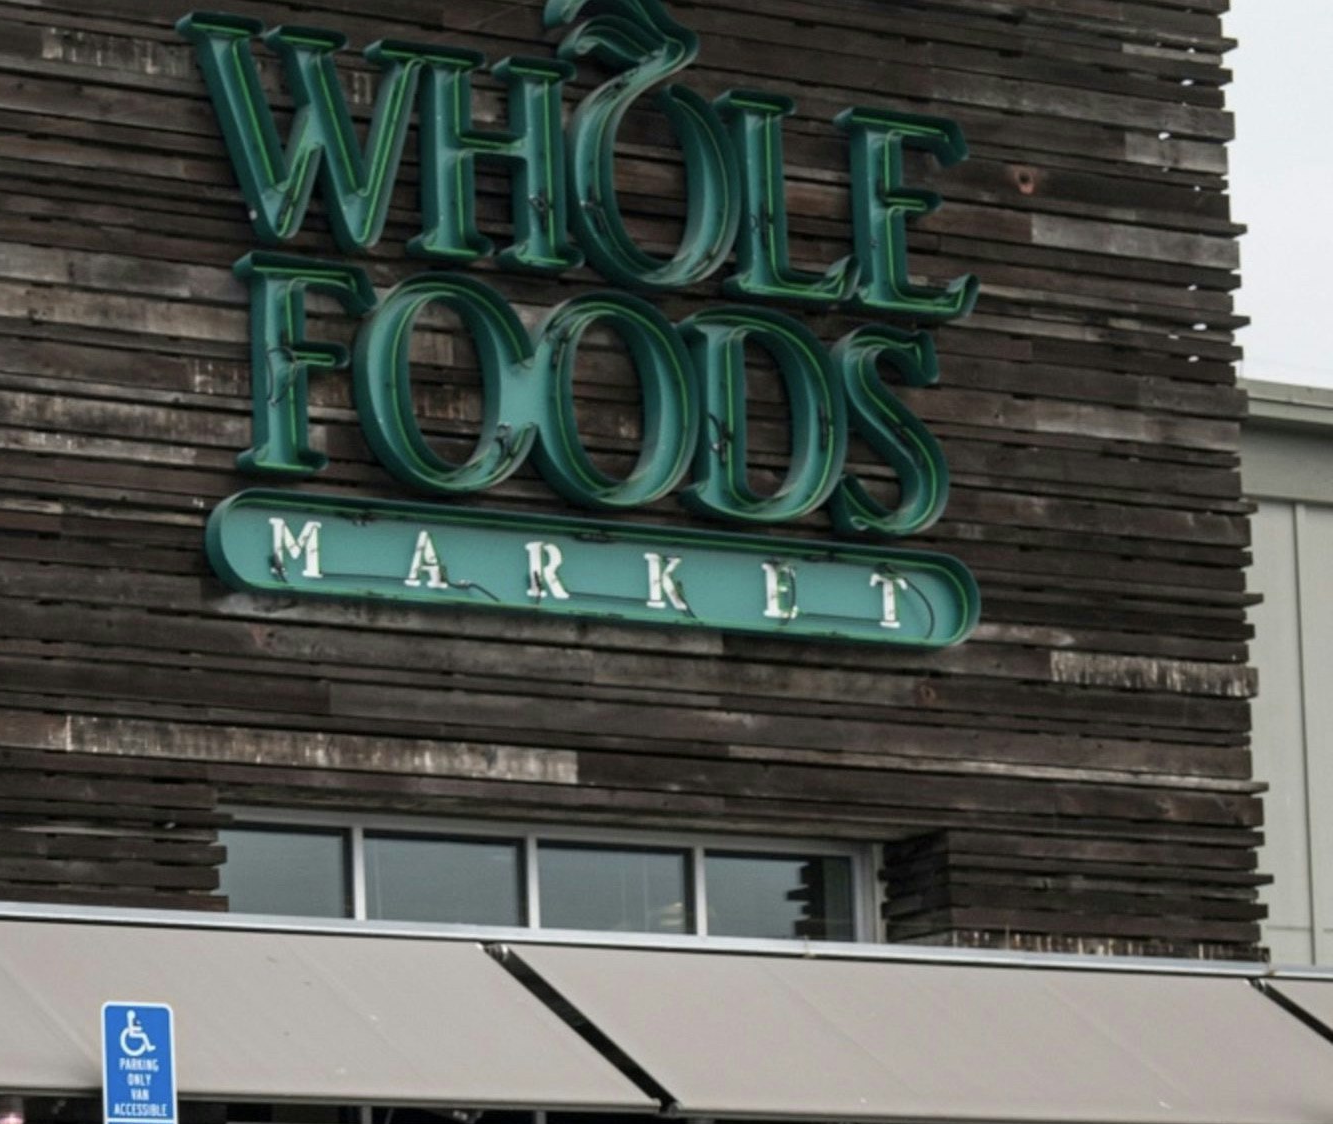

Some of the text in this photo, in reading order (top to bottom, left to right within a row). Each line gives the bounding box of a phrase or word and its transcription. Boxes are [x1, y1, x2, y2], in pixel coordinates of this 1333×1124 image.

[176, 6, 980, 321] WHOLE
[233, 250, 950, 537] FOODS
[268, 517, 908, 629] MARKET
[119, 1057, 160, 1072] PARKING
[126, 1073, 152, 1087] ONLY
[130, 1089, 150, 1101] VAN
[113, 1103, 168, 1117] ACCESSIBLE
